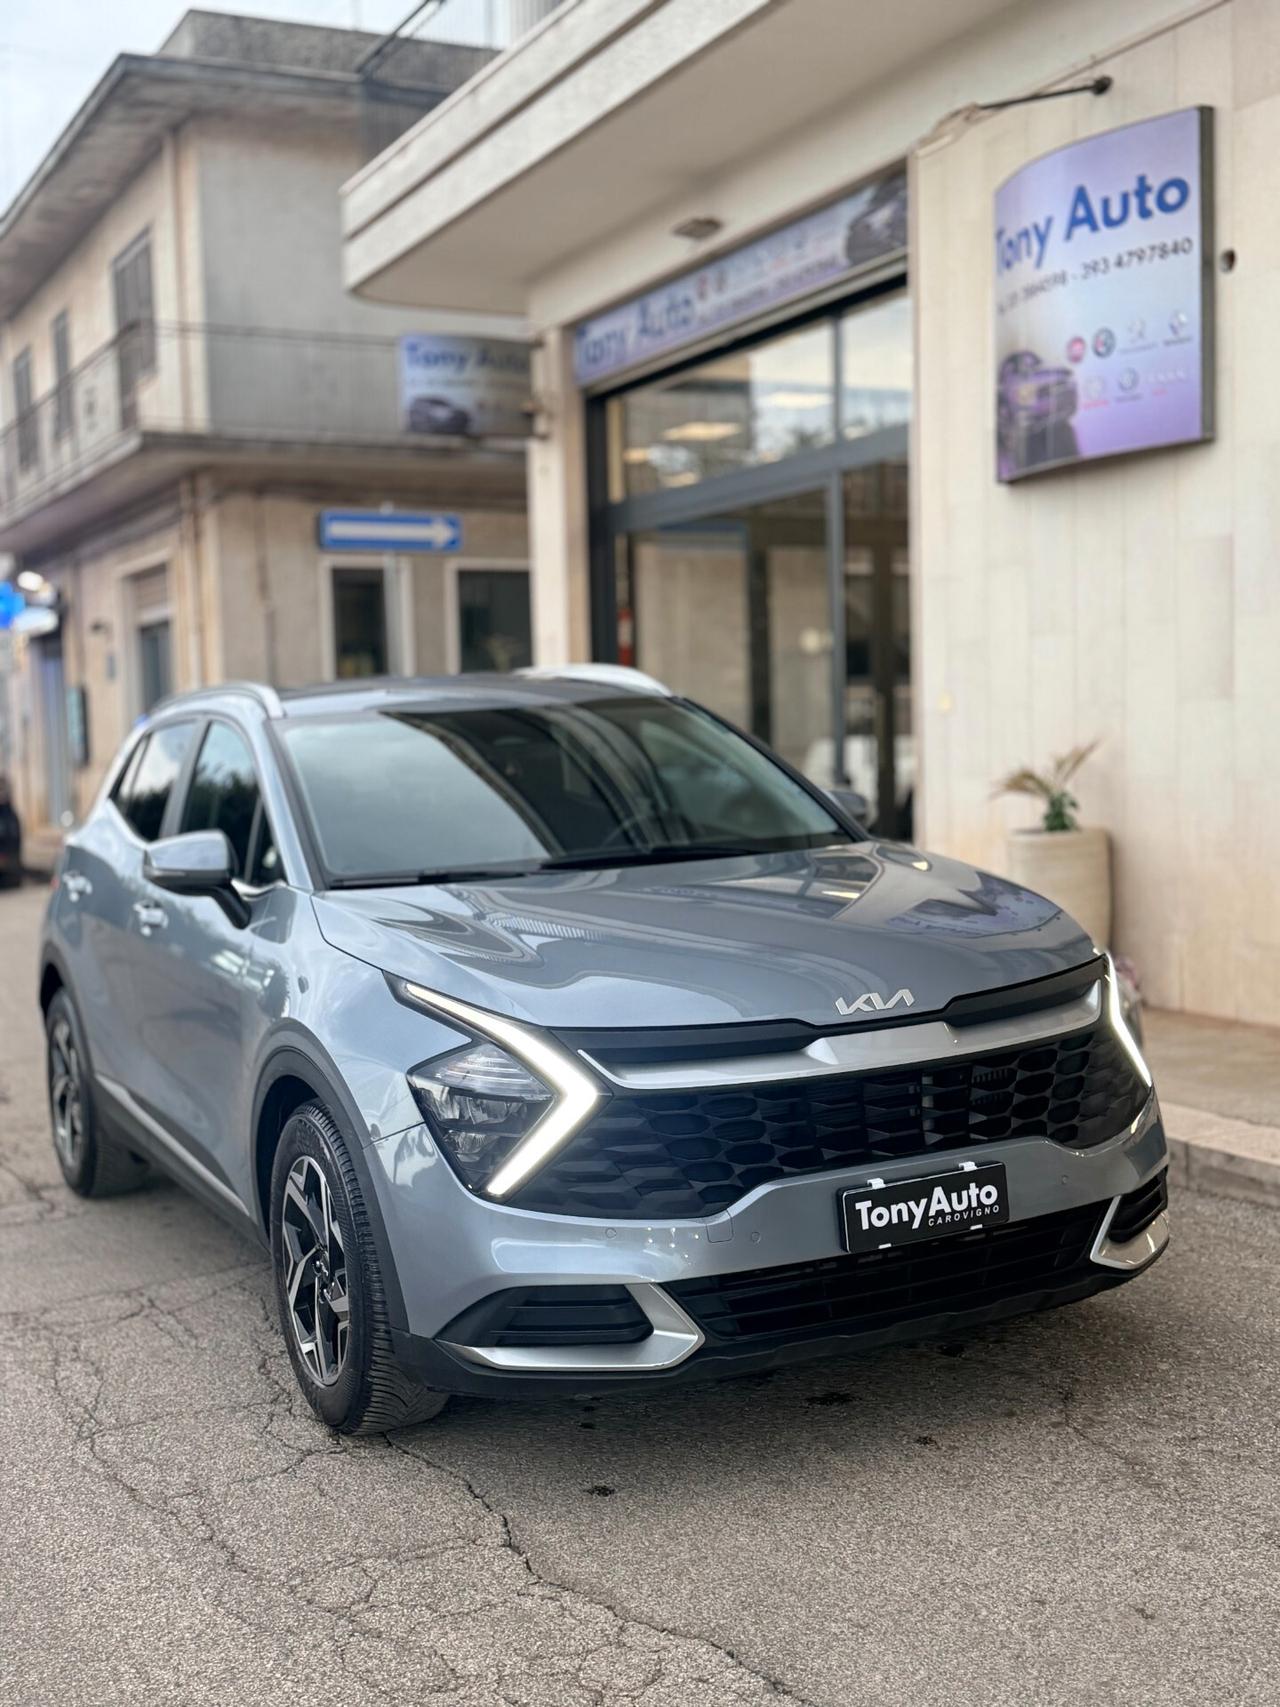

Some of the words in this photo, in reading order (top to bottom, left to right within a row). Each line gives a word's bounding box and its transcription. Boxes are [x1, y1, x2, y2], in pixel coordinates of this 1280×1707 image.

[995, 216, 1053, 276] Tony
[1064, 174, 1190, 242] Auto
[576, 316, 634, 370] Tony
[637, 290, 694, 337] Auto
[406, 341, 467, 373] Tony
[835, 988, 915, 1016] KIA
[855, 1182, 998, 1230] TonyAuto
[928, 1204, 1000, 1227] CAROVIGNO
